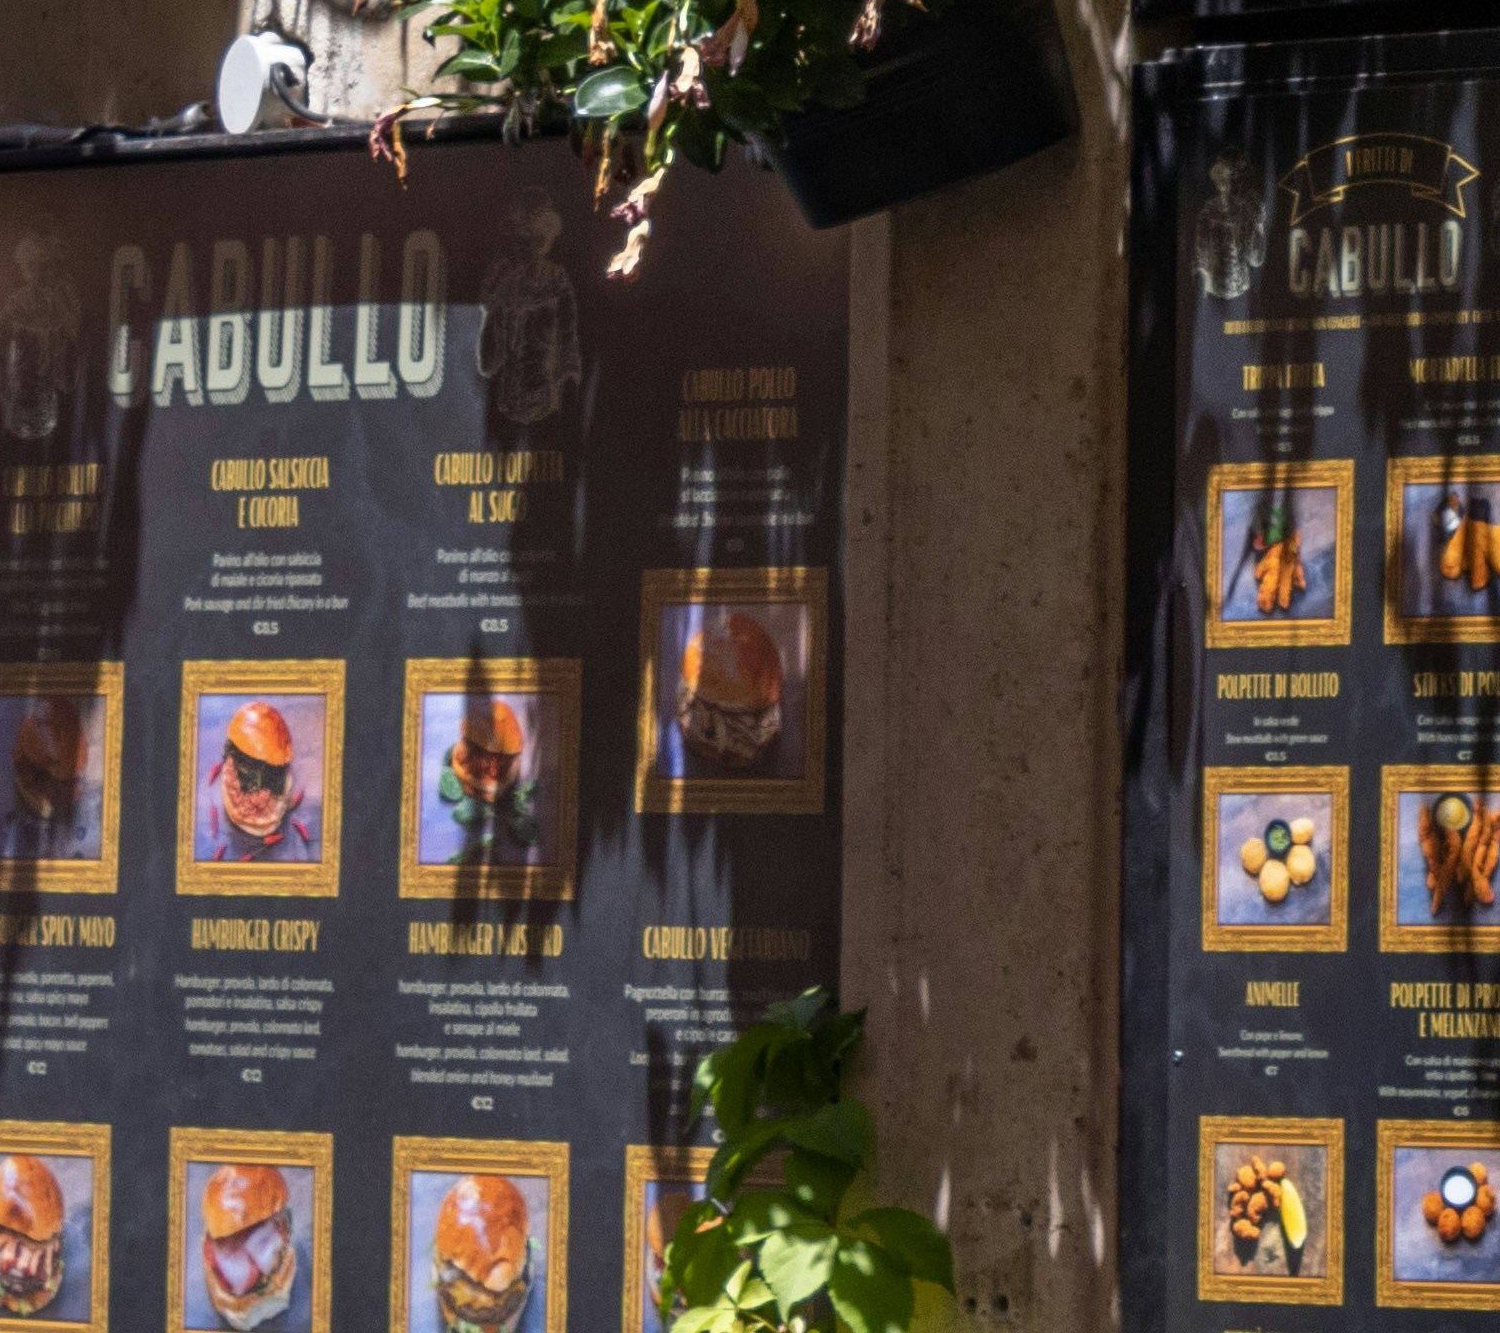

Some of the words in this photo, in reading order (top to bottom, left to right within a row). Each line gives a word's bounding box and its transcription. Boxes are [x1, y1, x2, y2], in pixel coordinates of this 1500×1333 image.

[1288, 220, 1463, 297] CABULLO
[107, 231, 446, 407] CABULLO
[749, 366, 796, 400] POLLO
[212, 459, 266, 491] CABULLO
[269, 456, 329, 490] SALSICCIA
[435, 452, 494, 485] CABULLO
[238, 496, 246, 528] E
[249, 495, 299, 528] CICORIA
[468, 491, 485, 523] AL
[489, 490, 528, 523] SUGO
[1217, 673, 1272, 699] POLPETTE
[1275, 673, 1286, 698] DI
[1290, 672, 1339, 698] BOLLITO
[1460, 671, 1473, 697] DI
[41, 915, 76, 947] SPICY
[79, 915, 116, 948] MAYO
[191, 918, 270, 951] HAMBURGER
[274, 919, 321, 952] CRISPY
[409, 921, 493, 955] HAMBURGER
[497, 923, 564, 957] MUSRD
[643, 925, 707, 960] CABULLO
[1245, 981, 1300, 1007] ANIMELLE
[1390, 982, 1453, 1008] POLPETTE
[1457, 982, 1469, 1009] DI
[1419, 1012, 1427, 1038] E
